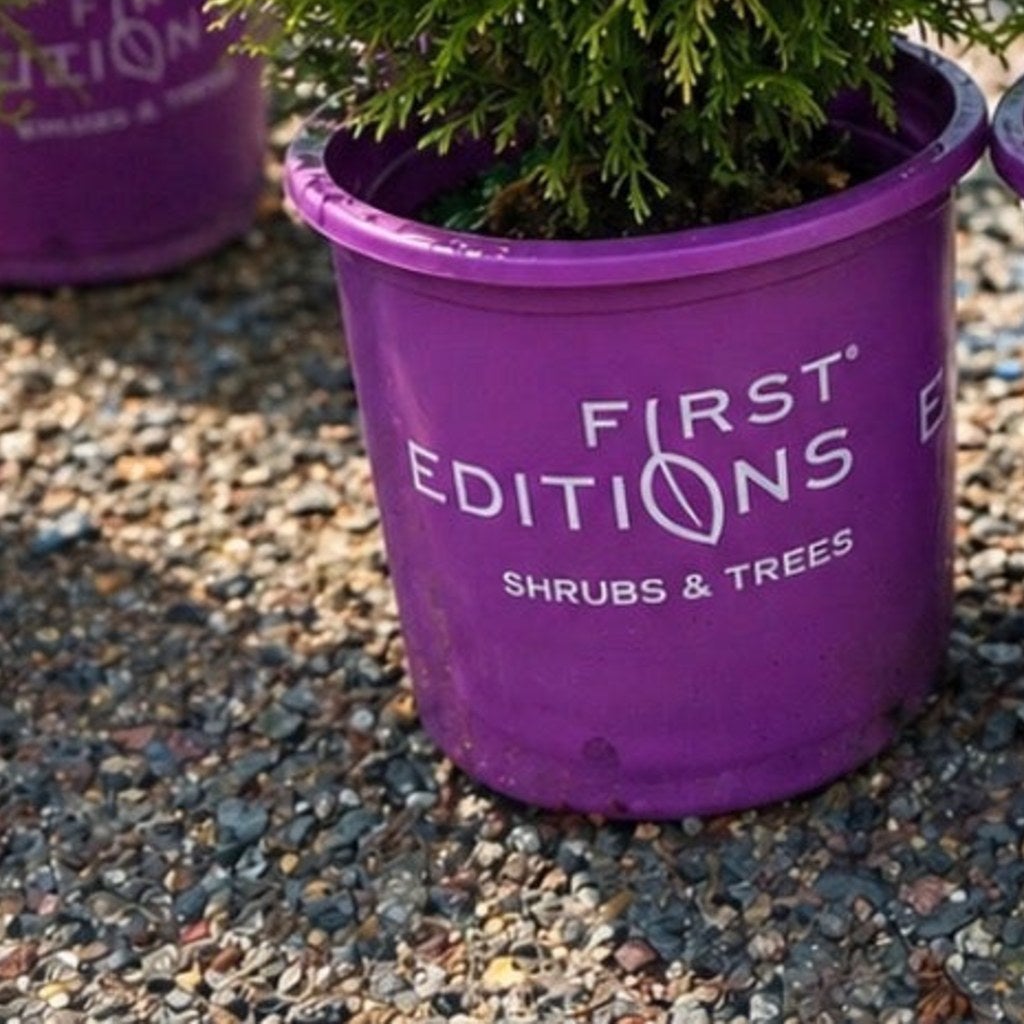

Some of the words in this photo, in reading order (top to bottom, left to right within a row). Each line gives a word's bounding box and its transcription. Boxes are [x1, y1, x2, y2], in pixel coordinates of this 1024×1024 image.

[407, 428, 855, 546] EDITIONS
[502, 571, 668, 607] SHRUBS
[682, 573, 712, 602] &
[724, 528, 855, 591] TREES
